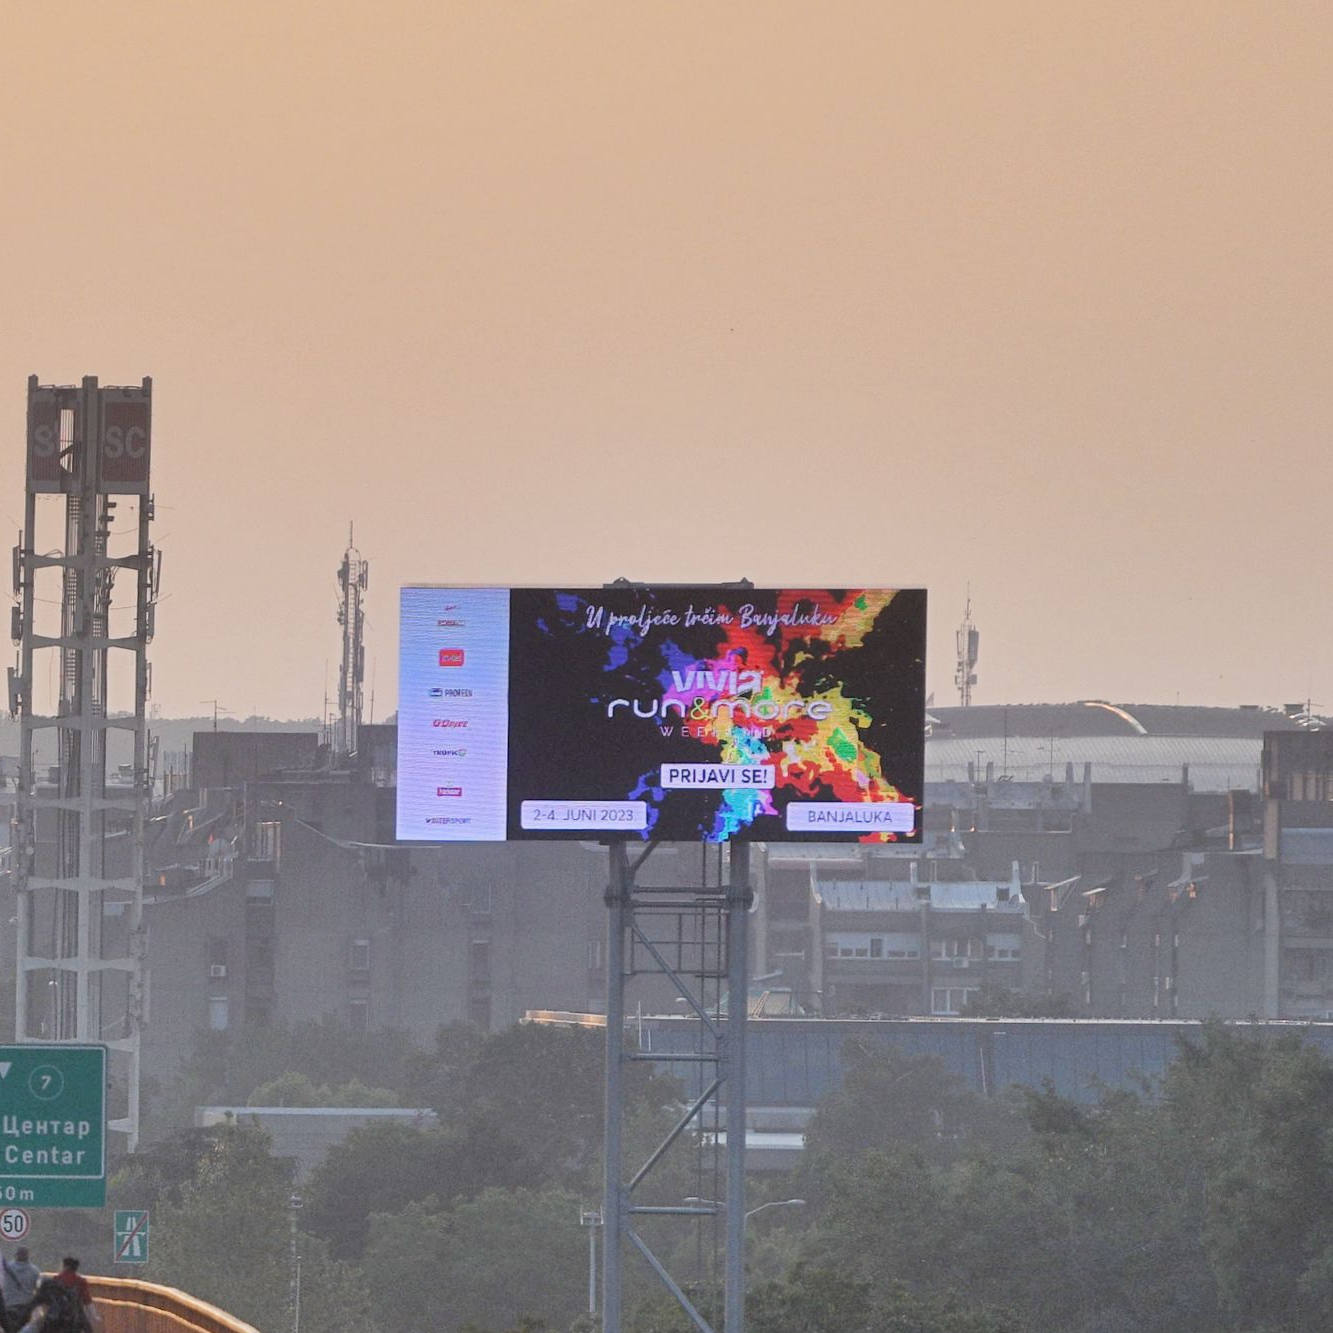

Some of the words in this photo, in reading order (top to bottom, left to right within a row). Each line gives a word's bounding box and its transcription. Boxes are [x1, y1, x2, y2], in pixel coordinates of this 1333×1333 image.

[105, 425, 146, 459] SC
[607, 697, 834, 721] run&more
[669, 768, 735, 784] PRIJAVI
[740, 768, 768, 784] SE!
[563, 809, 596, 821] JUNI
[808, 810, 893, 824] BANJALUKA
[41, 1076, 52, 1090] 7
[2, 1115, 91, 1139] Центар
[5, 1145, 86, 1165] Centar
[3, 1215, 23, 1234] 50
